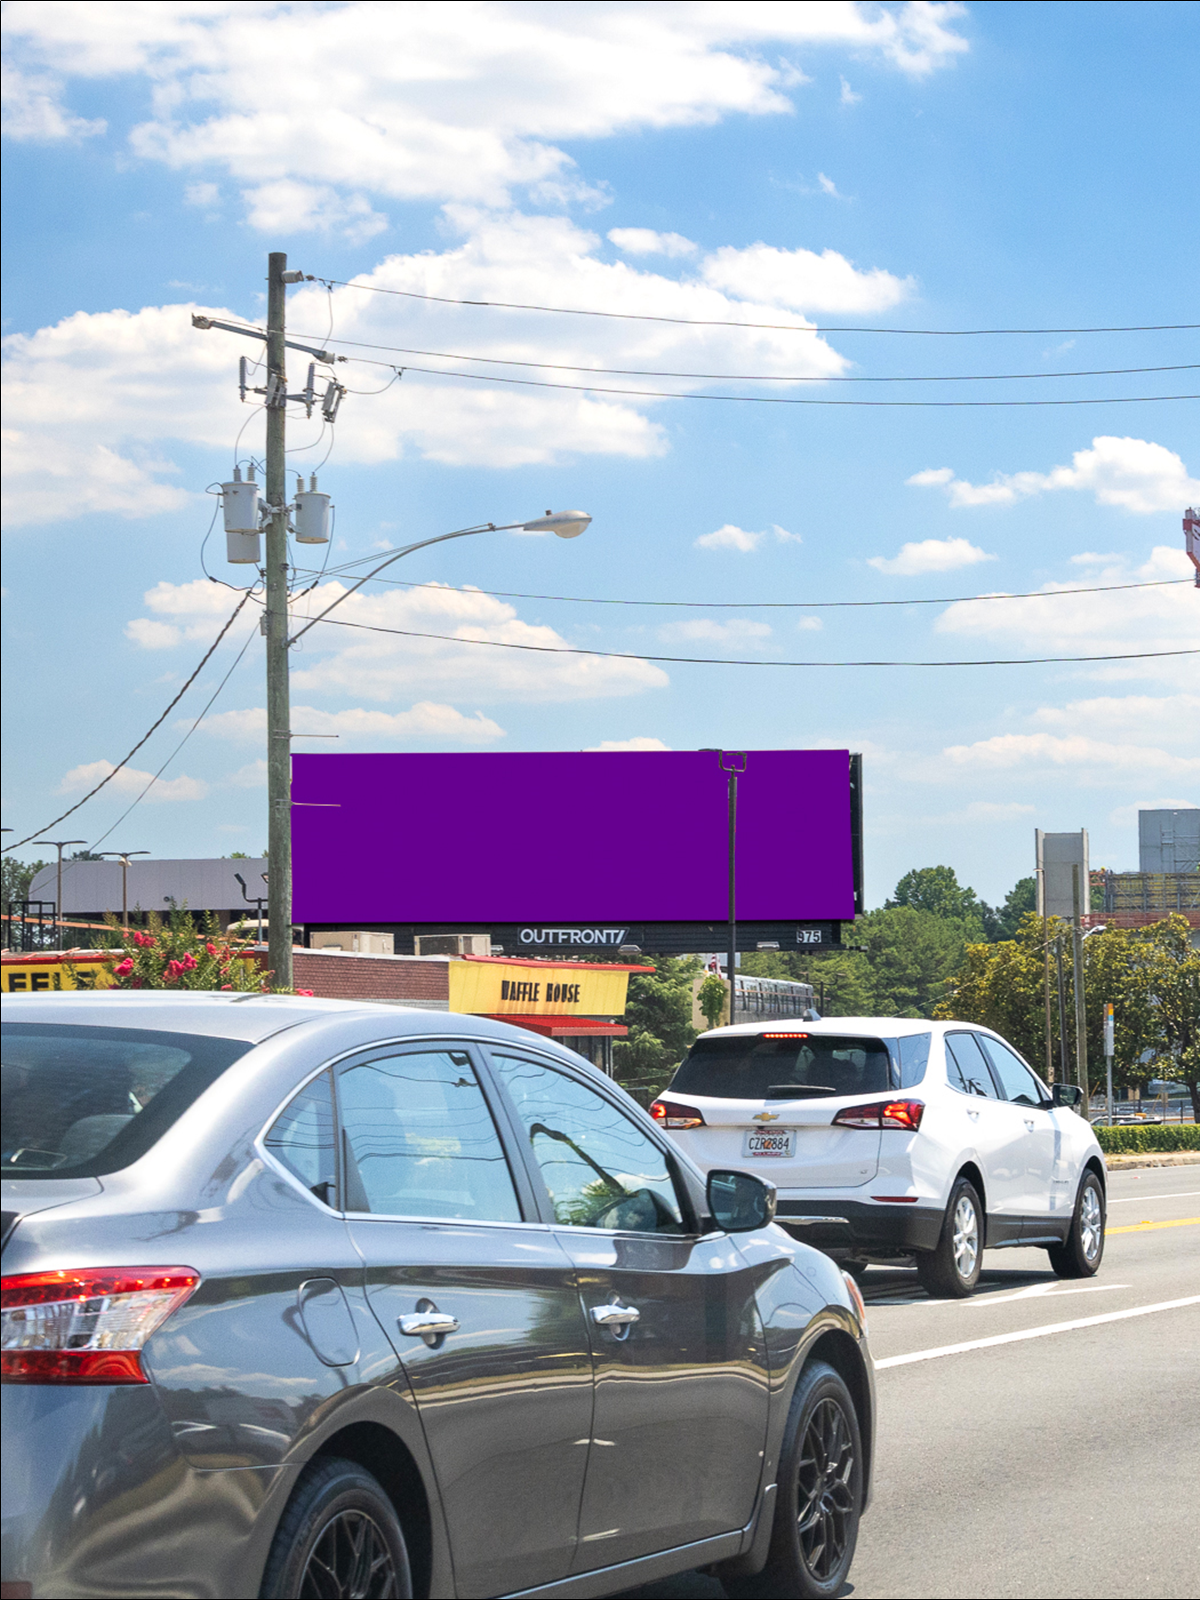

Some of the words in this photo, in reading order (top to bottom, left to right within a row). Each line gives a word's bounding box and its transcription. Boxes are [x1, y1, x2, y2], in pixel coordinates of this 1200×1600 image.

[797, 930, 821, 943] 975
[501, 980, 540, 1002] WAFFLE
[546, 983, 581, 1003] HOUSE
[749, 1137, 789, 1150] CZR2884
